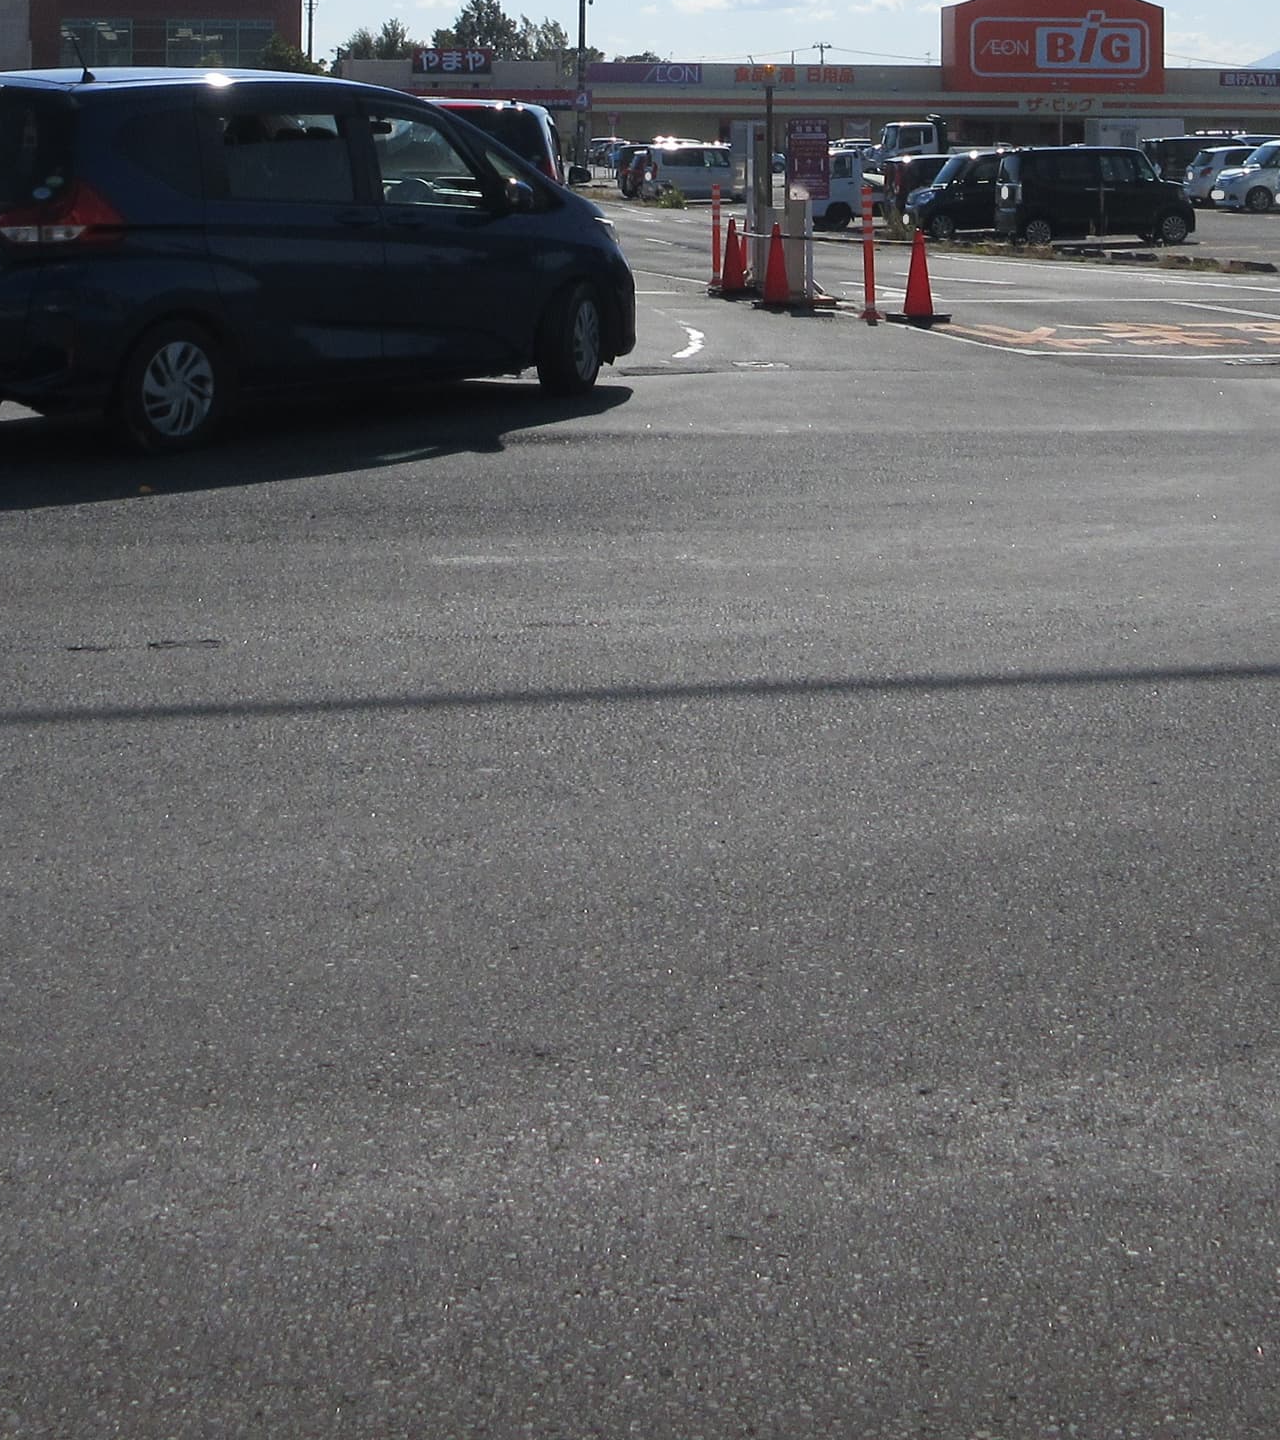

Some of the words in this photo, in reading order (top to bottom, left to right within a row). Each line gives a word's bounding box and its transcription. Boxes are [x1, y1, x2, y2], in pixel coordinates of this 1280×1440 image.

[421, 51, 486, 72] やまや
[807, 67, 855, 84] 日用品
[575, 93, 588, 107] 4
